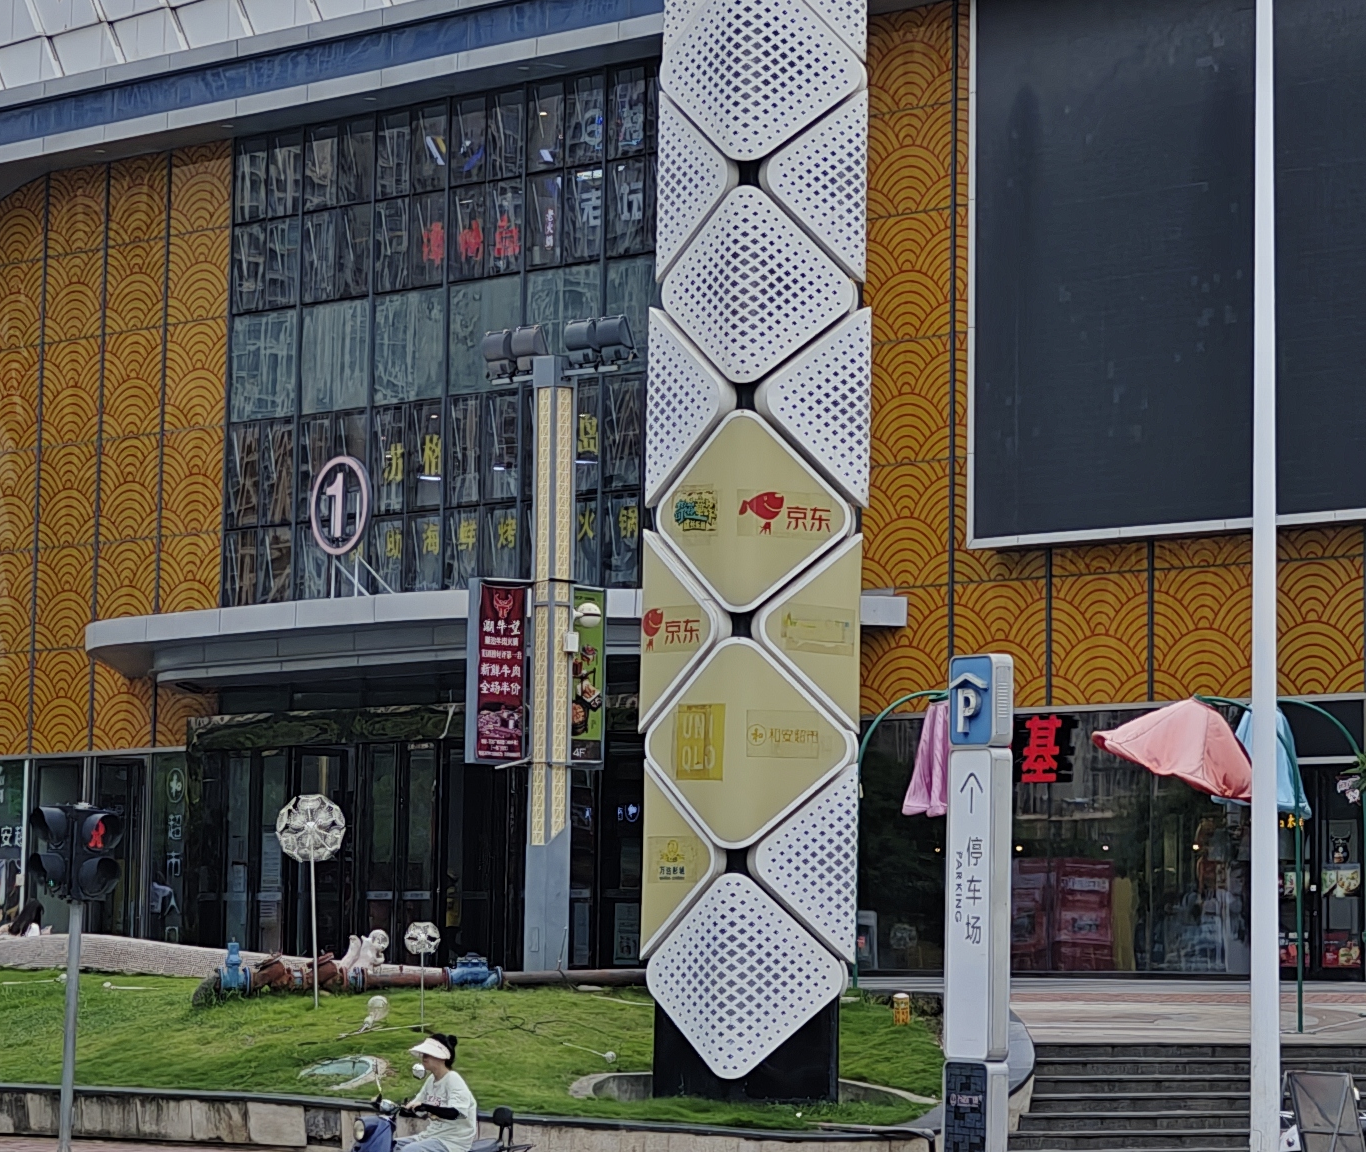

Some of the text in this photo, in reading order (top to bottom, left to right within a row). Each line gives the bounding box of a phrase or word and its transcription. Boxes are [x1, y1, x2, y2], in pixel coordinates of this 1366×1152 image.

[786, 506, 831, 532] 京东
[665, 618, 700, 645] 京东
[480, 663, 521, 677] 新鲜牛肉
[480, 681, 521, 695] 全场半价
[957, 688, 983, 733] P
[769, 727, 818, 743] 和安超市
[573, 749, 586, 757] 4F
[1021, 714, 1062, 783] 基
[955, 850, 963, 923] PARKING
[965, 836, 983, 945] 停车场
